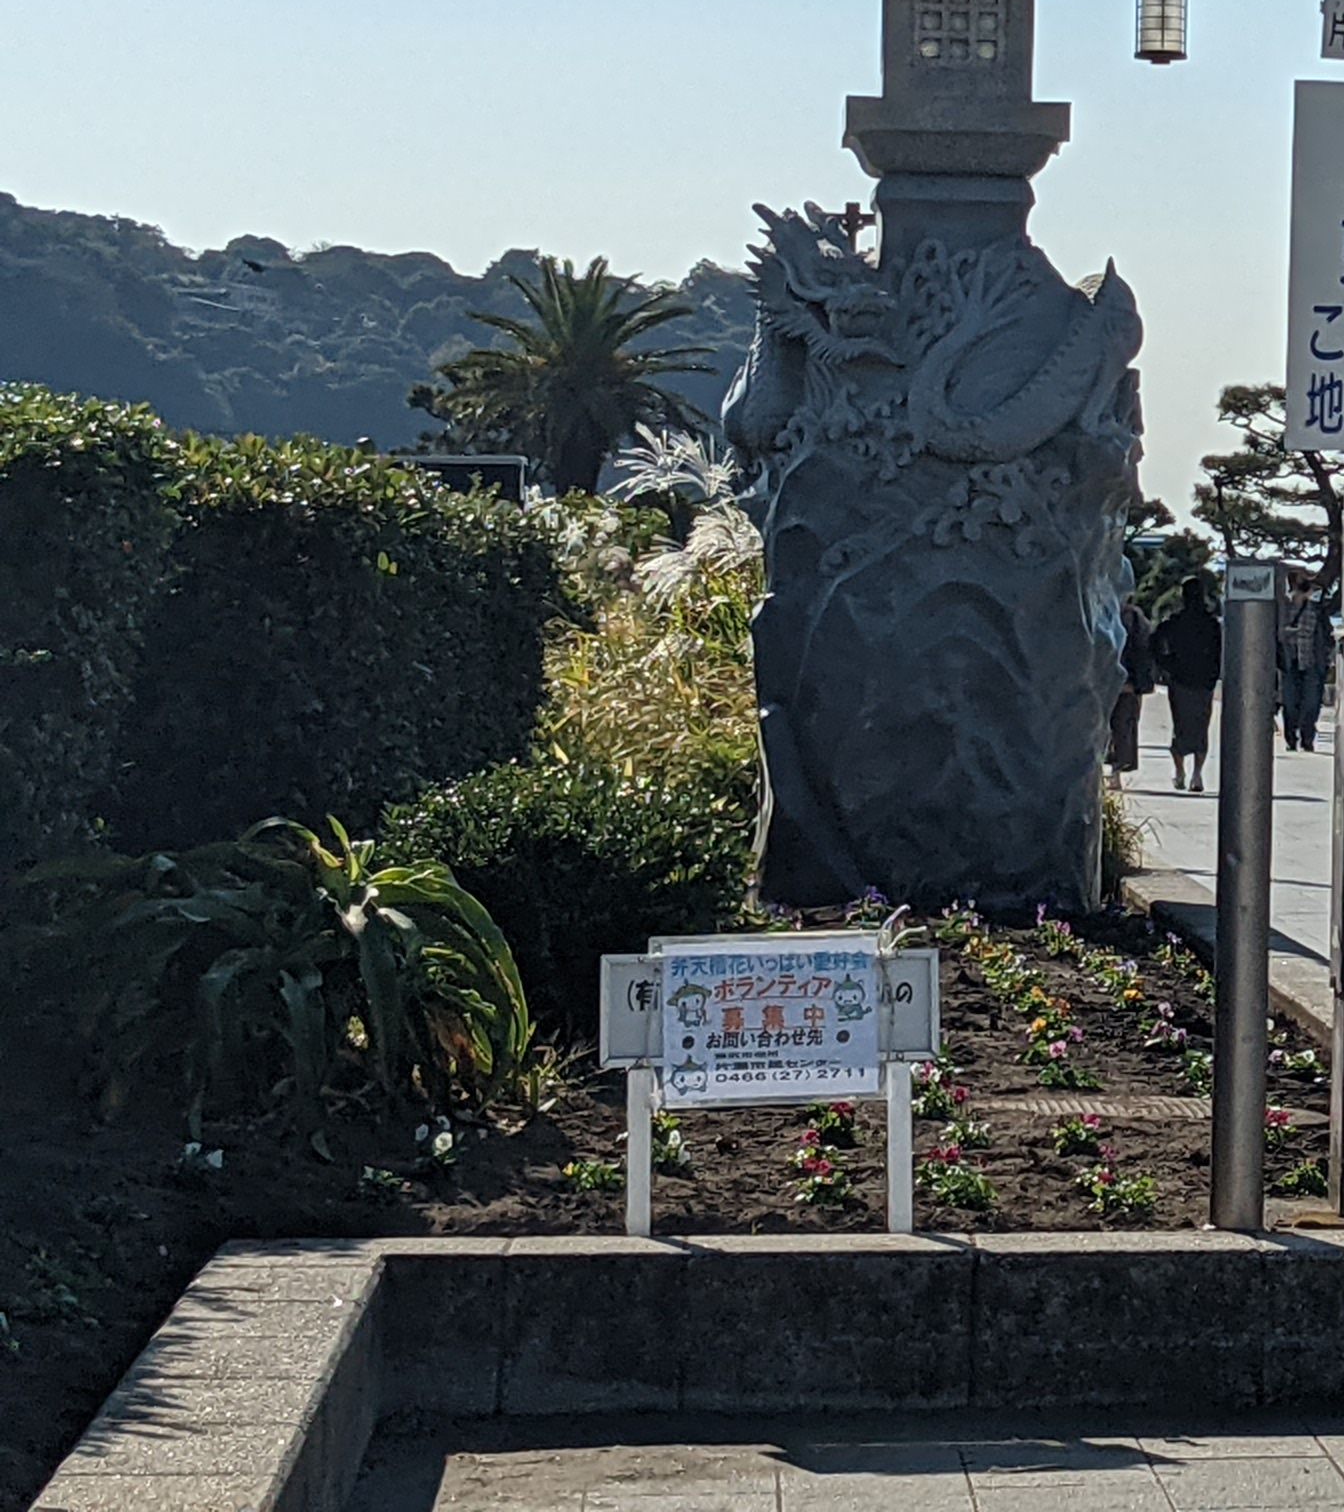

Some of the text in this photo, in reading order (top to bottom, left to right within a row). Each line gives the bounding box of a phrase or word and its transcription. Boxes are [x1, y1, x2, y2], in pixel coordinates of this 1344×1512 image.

[713, 974, 833, 1000] ボランティア
[705, 1029, 824, 1050] お問い合わせ先
